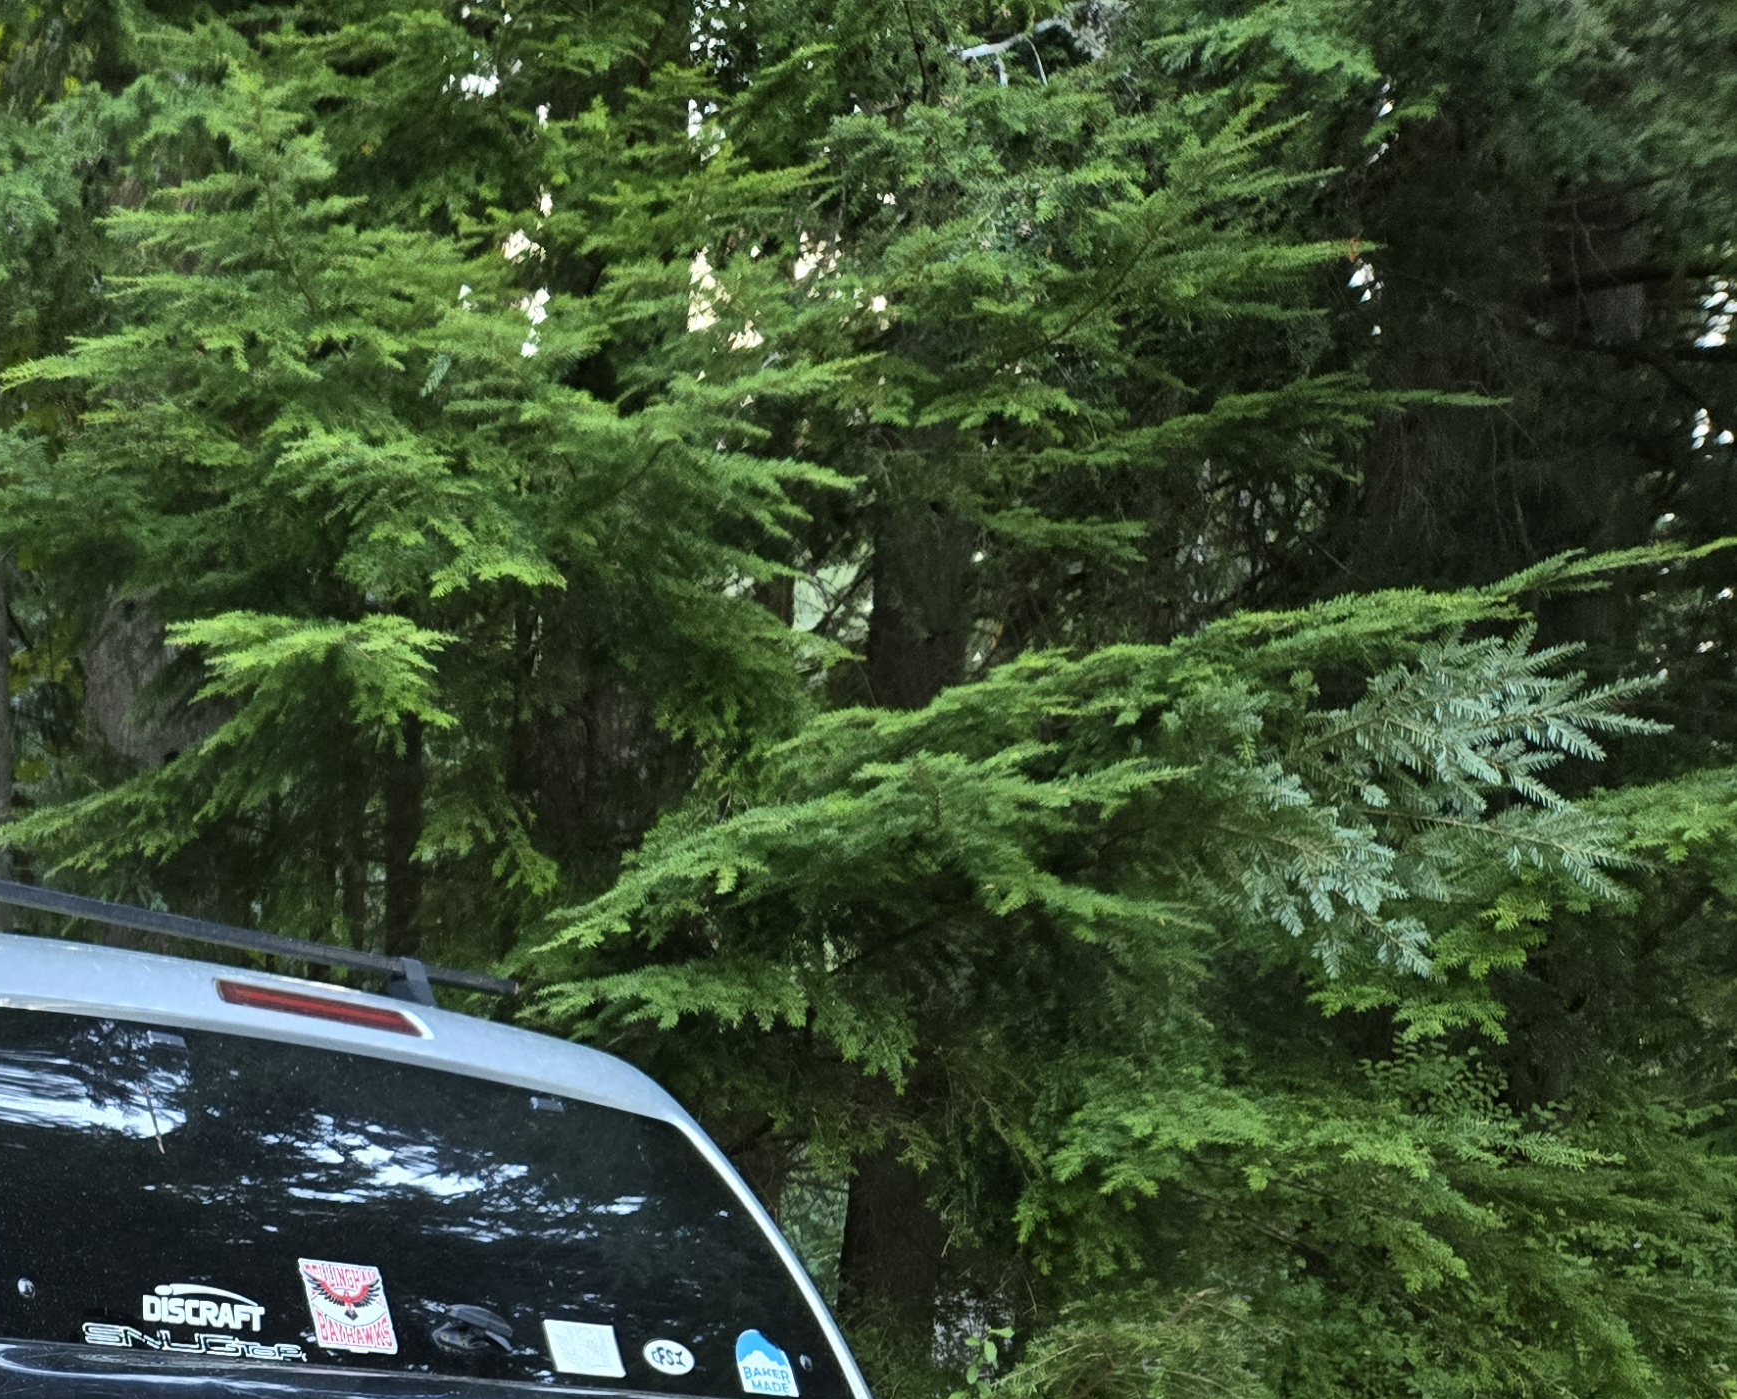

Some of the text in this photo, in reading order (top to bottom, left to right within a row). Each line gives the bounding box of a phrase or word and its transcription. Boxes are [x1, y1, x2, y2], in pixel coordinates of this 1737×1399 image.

[142, 1284, 265, 1332] DISCRAFT
[315, 1309, 393, 1347] BAYHAWKS
[743, 1366, 791, 1384] BAKER
[751, 1380, 789, 1393] MADE
